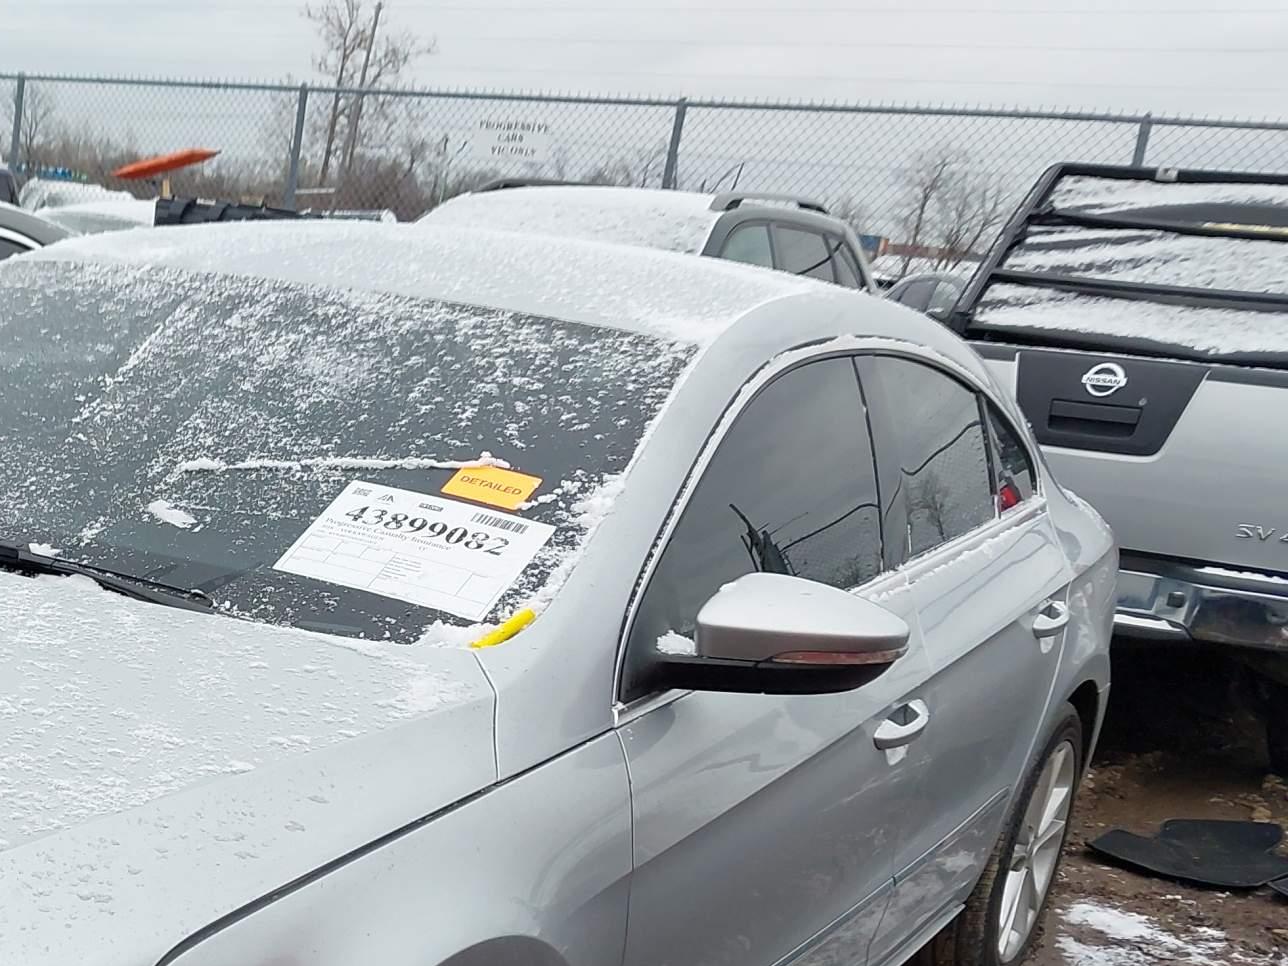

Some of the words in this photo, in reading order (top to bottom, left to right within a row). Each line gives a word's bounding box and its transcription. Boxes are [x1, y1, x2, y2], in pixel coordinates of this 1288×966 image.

[1086, 376, 1121, 385] NISSAN
[460, 475, 523, 495] DETAILED
[345, 506, 510, 556] 43899082
